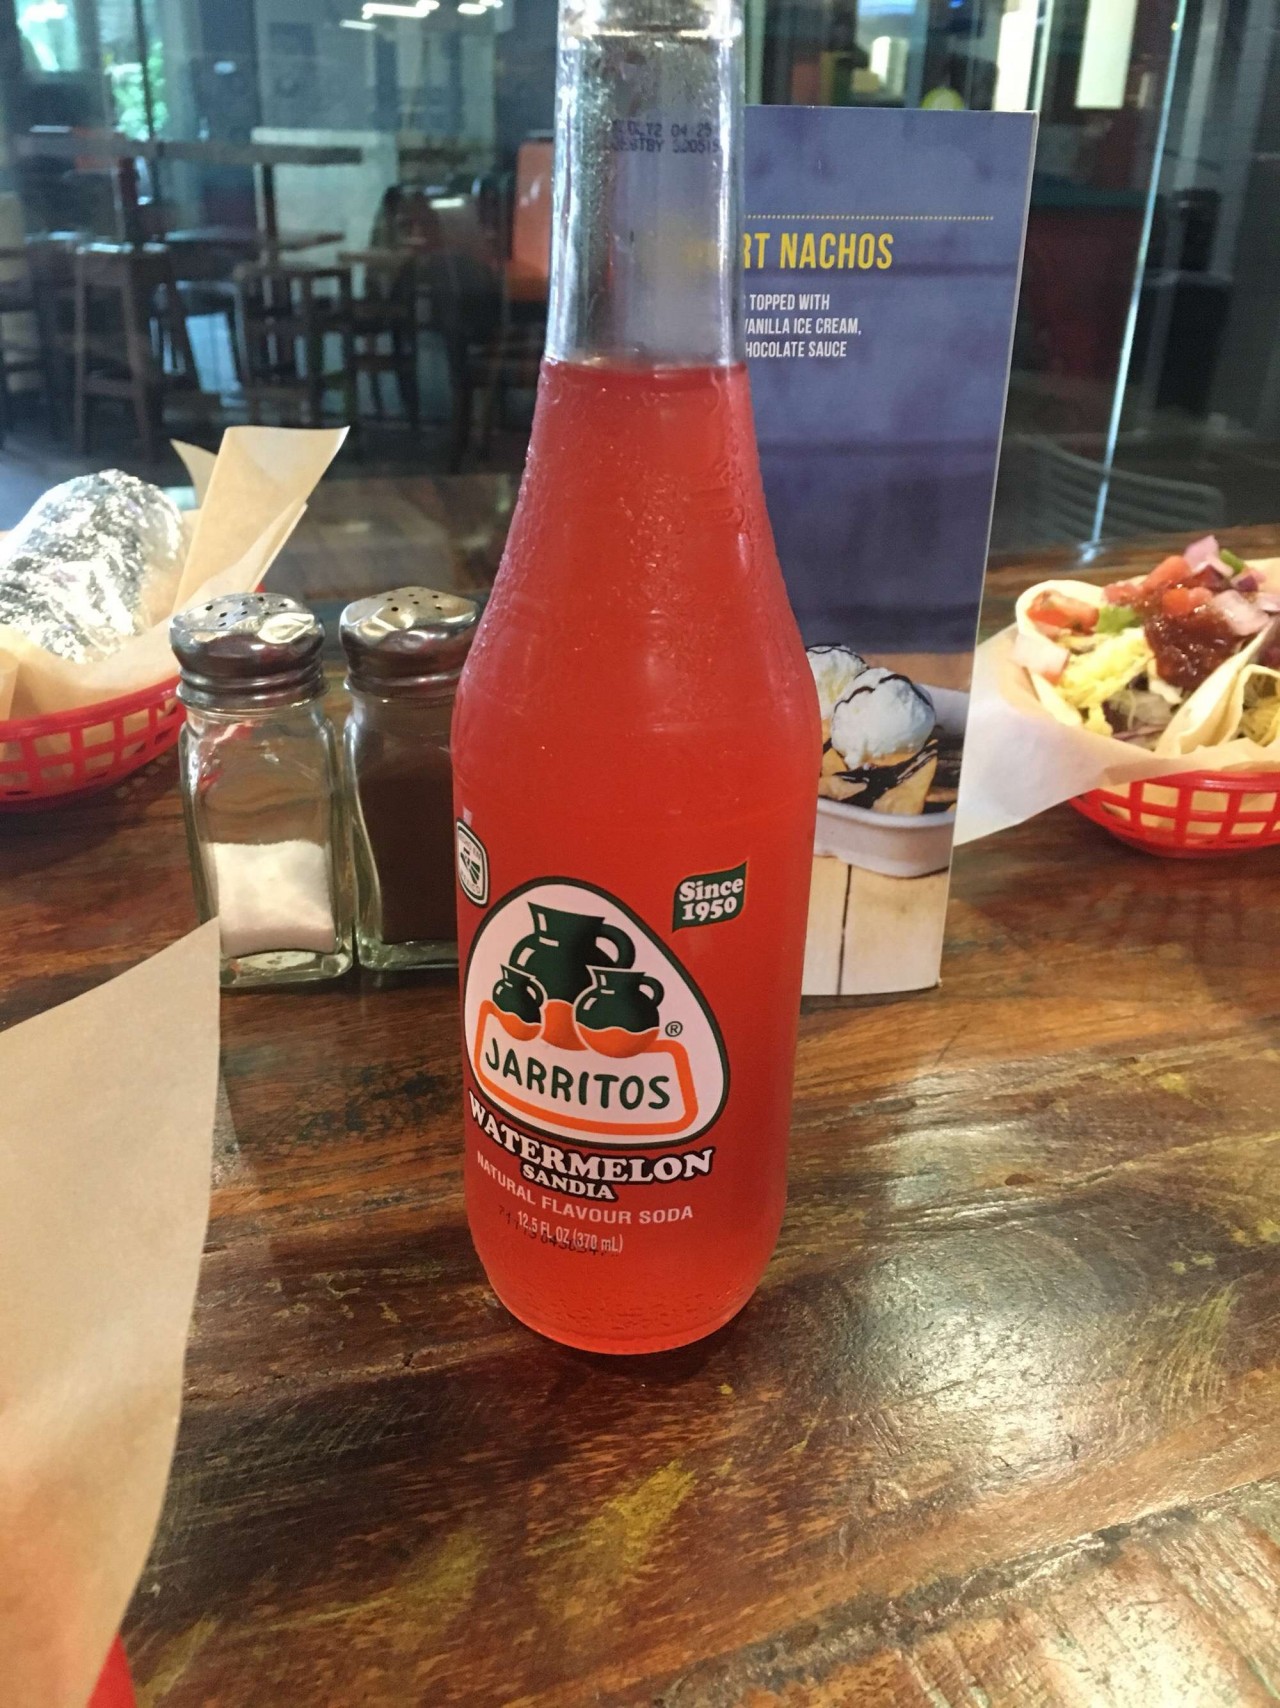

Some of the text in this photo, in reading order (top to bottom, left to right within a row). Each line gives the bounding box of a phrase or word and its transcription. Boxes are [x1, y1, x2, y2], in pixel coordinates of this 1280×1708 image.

[780, 232, 894, 270] NACHOS
[750, 293, 796, 311] TOPPED
[799, 293, 831, 311] WITH
[793, 318, 812, 334] ICE
[815, 317, 862, 336] CREAM,
[808, 341, 847, 357] SAUCE
[679, 876, 744, 902] Since
[682, 896, 738, 922] 1950
[485, 1037, 670, 1110] JARRITOS
[469, 1090, 714, 1183] WATERMELON
[477, 1151, 536, 1205] NATURAL
[541, 1195, 632, 1225] FLAVOUR
[638, 1206, 693, 1224] SODA
[522, 1164, 615, 1200] SANDIA
[518, 1210, 538, 1233] 12.5
[540, 1221, 552, 1239] FL
[555, 1226, 570, 1244] OZ
[573, 1228, 597, 1250] (370
